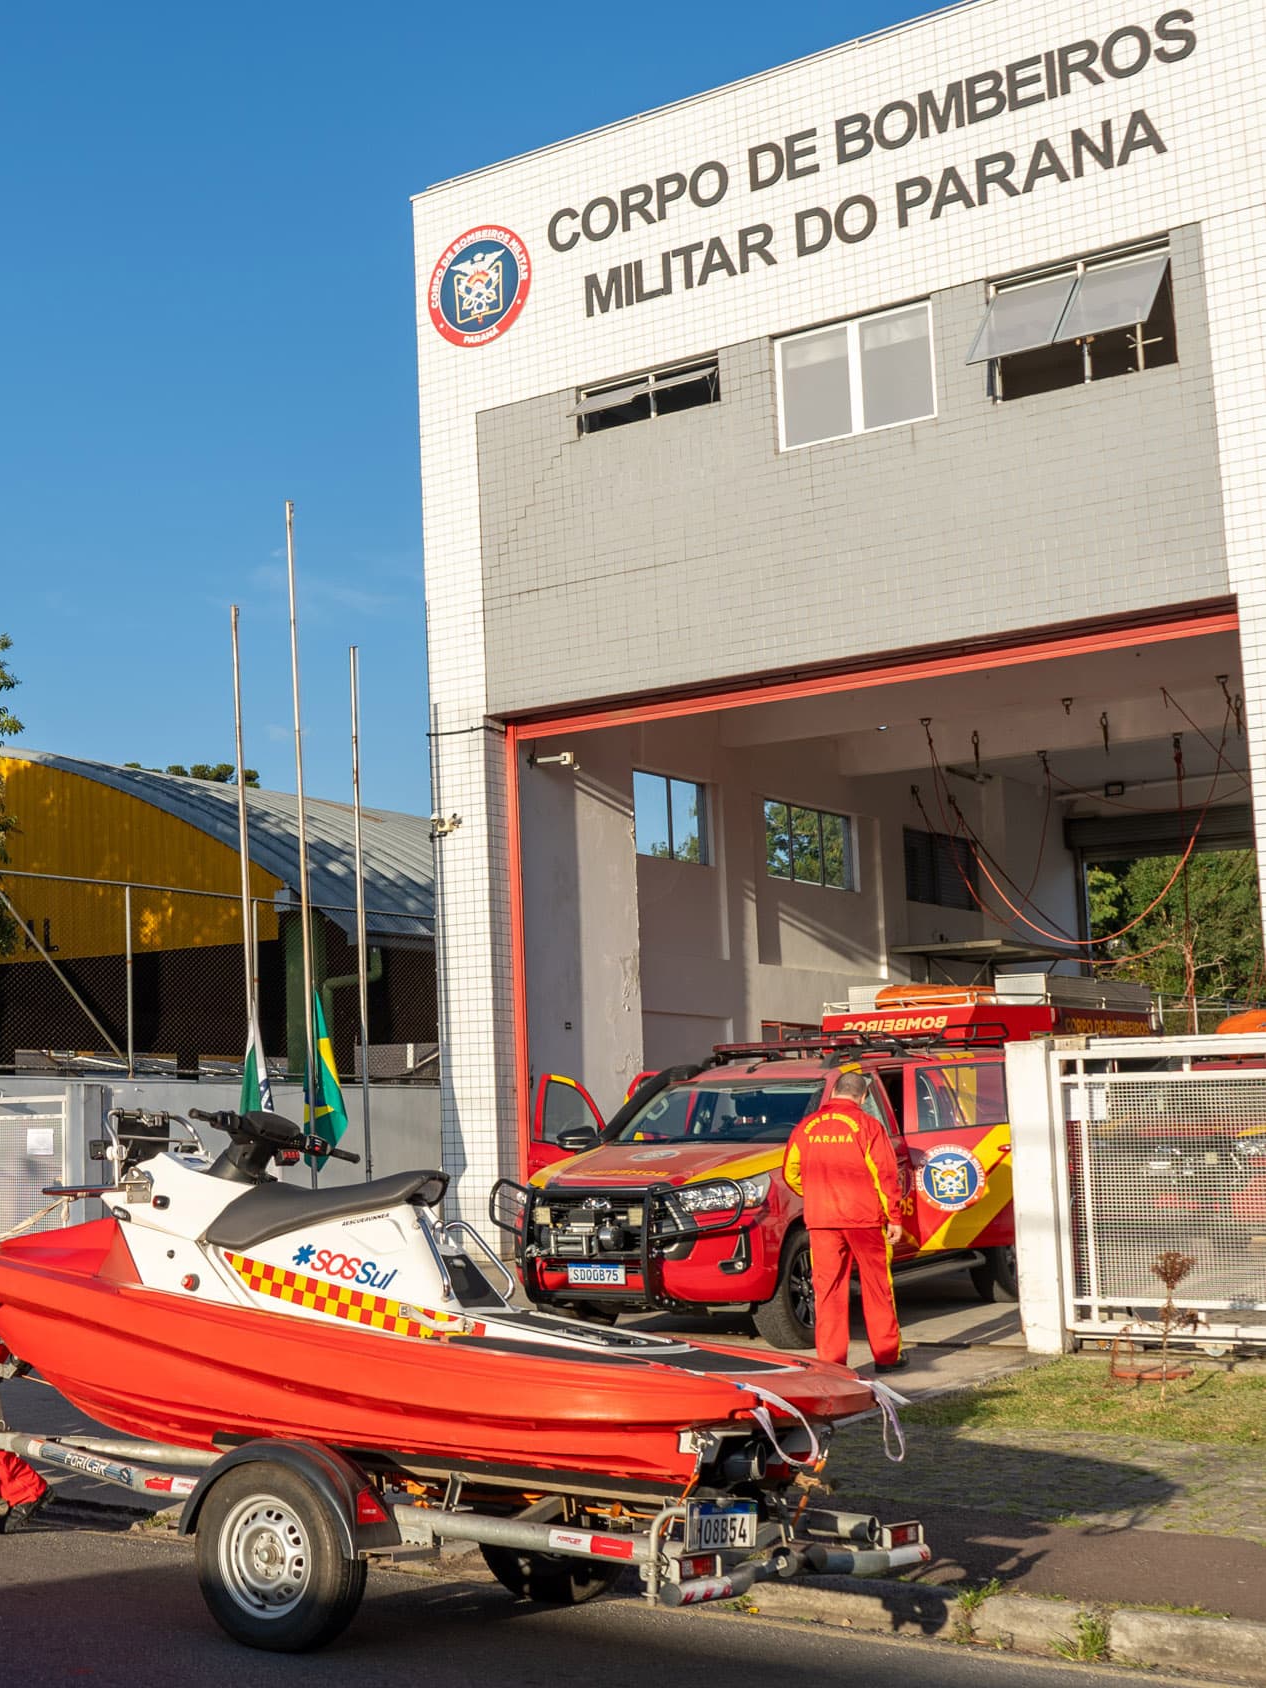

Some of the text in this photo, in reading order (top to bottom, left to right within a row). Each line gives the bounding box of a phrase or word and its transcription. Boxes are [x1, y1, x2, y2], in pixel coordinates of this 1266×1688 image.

[547, 8, 1199, 254] CORPO DE BOMBEIROS
[431, 229, 529, 309] CORPO DE BOMBEIROS MILITAR
[584, 108, 1170, 318] MILITAR DO PARANA
[1065, 1018, 1150, 1036] CORPO DE BOMBEIROS
